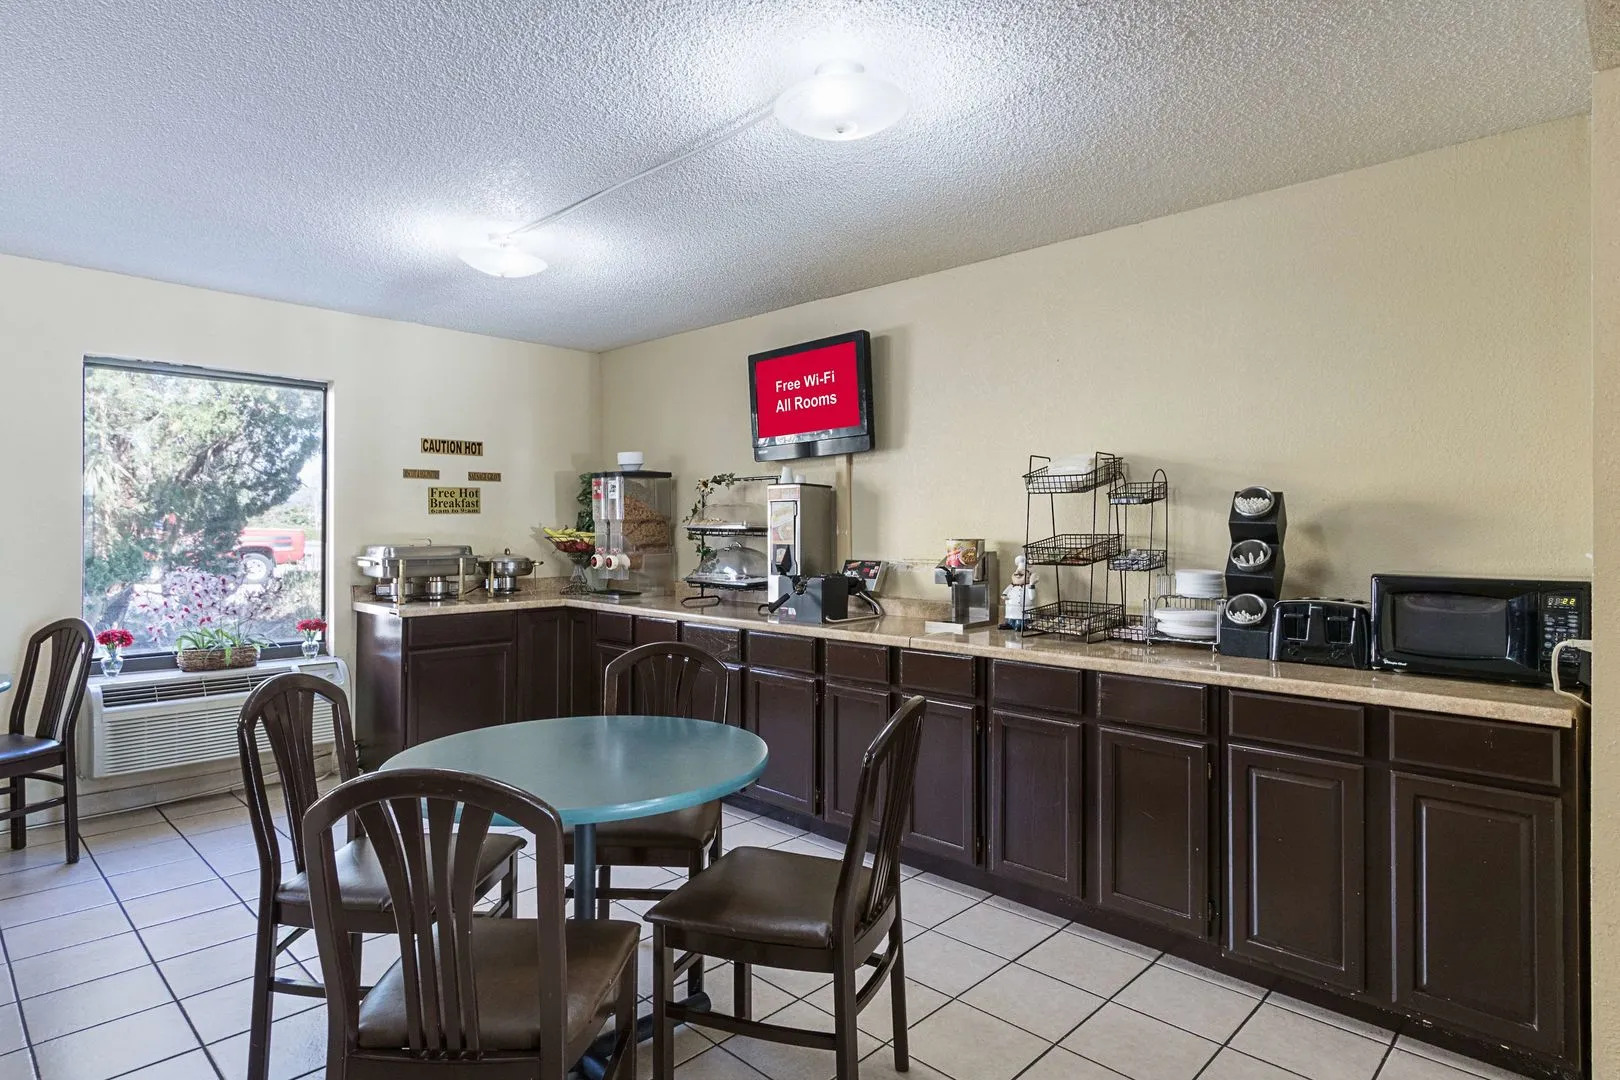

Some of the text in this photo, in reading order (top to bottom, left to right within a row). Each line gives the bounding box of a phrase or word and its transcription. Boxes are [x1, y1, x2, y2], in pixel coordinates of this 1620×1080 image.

[775, 370, 835, 393] Free Wi-Fi
[775, 393, 837, 413] All Rooms
[422, 438, 482, 455] CAUTION HOT
[430, 487, 479, 498] Free Hot
[430, 498, 479, 509] Breakfast
